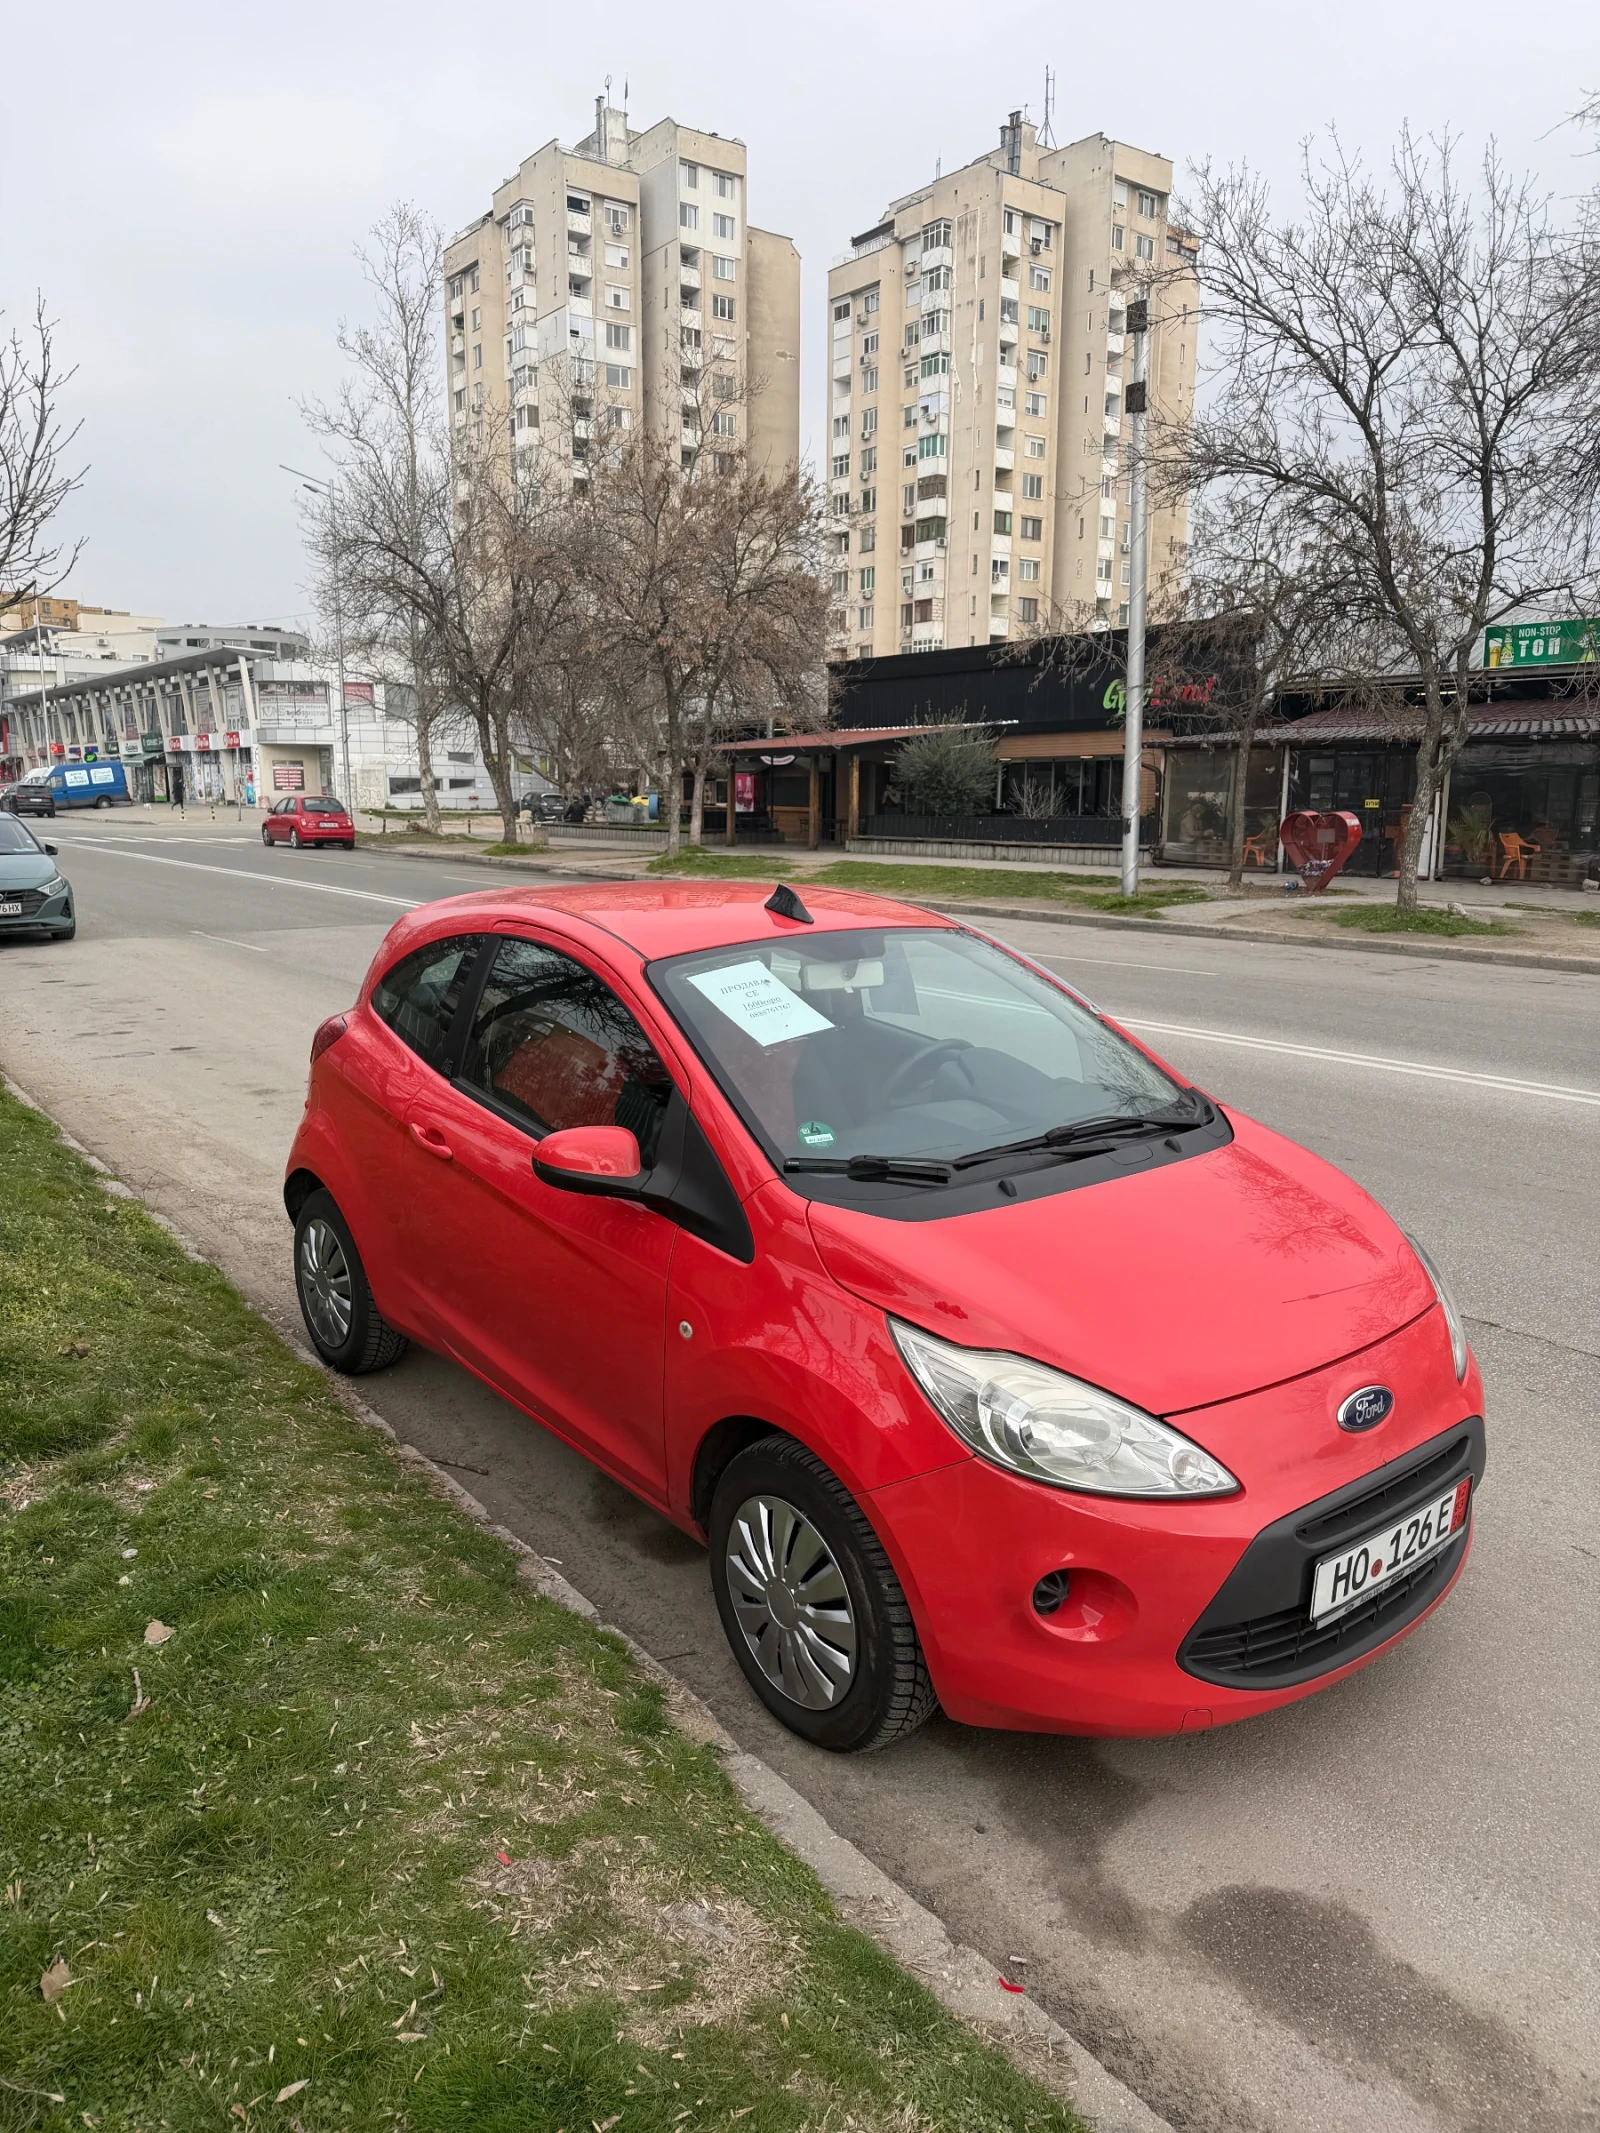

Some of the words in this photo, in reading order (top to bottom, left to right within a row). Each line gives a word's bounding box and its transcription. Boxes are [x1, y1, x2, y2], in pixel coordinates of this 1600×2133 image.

[1519, 625, 1561, 638] NON-STOP
[745, 989, 760, 998] СЕ
[1356, 1393, 1386, 1424] Ford
[1331, 1547, 1369, 1604] HO
